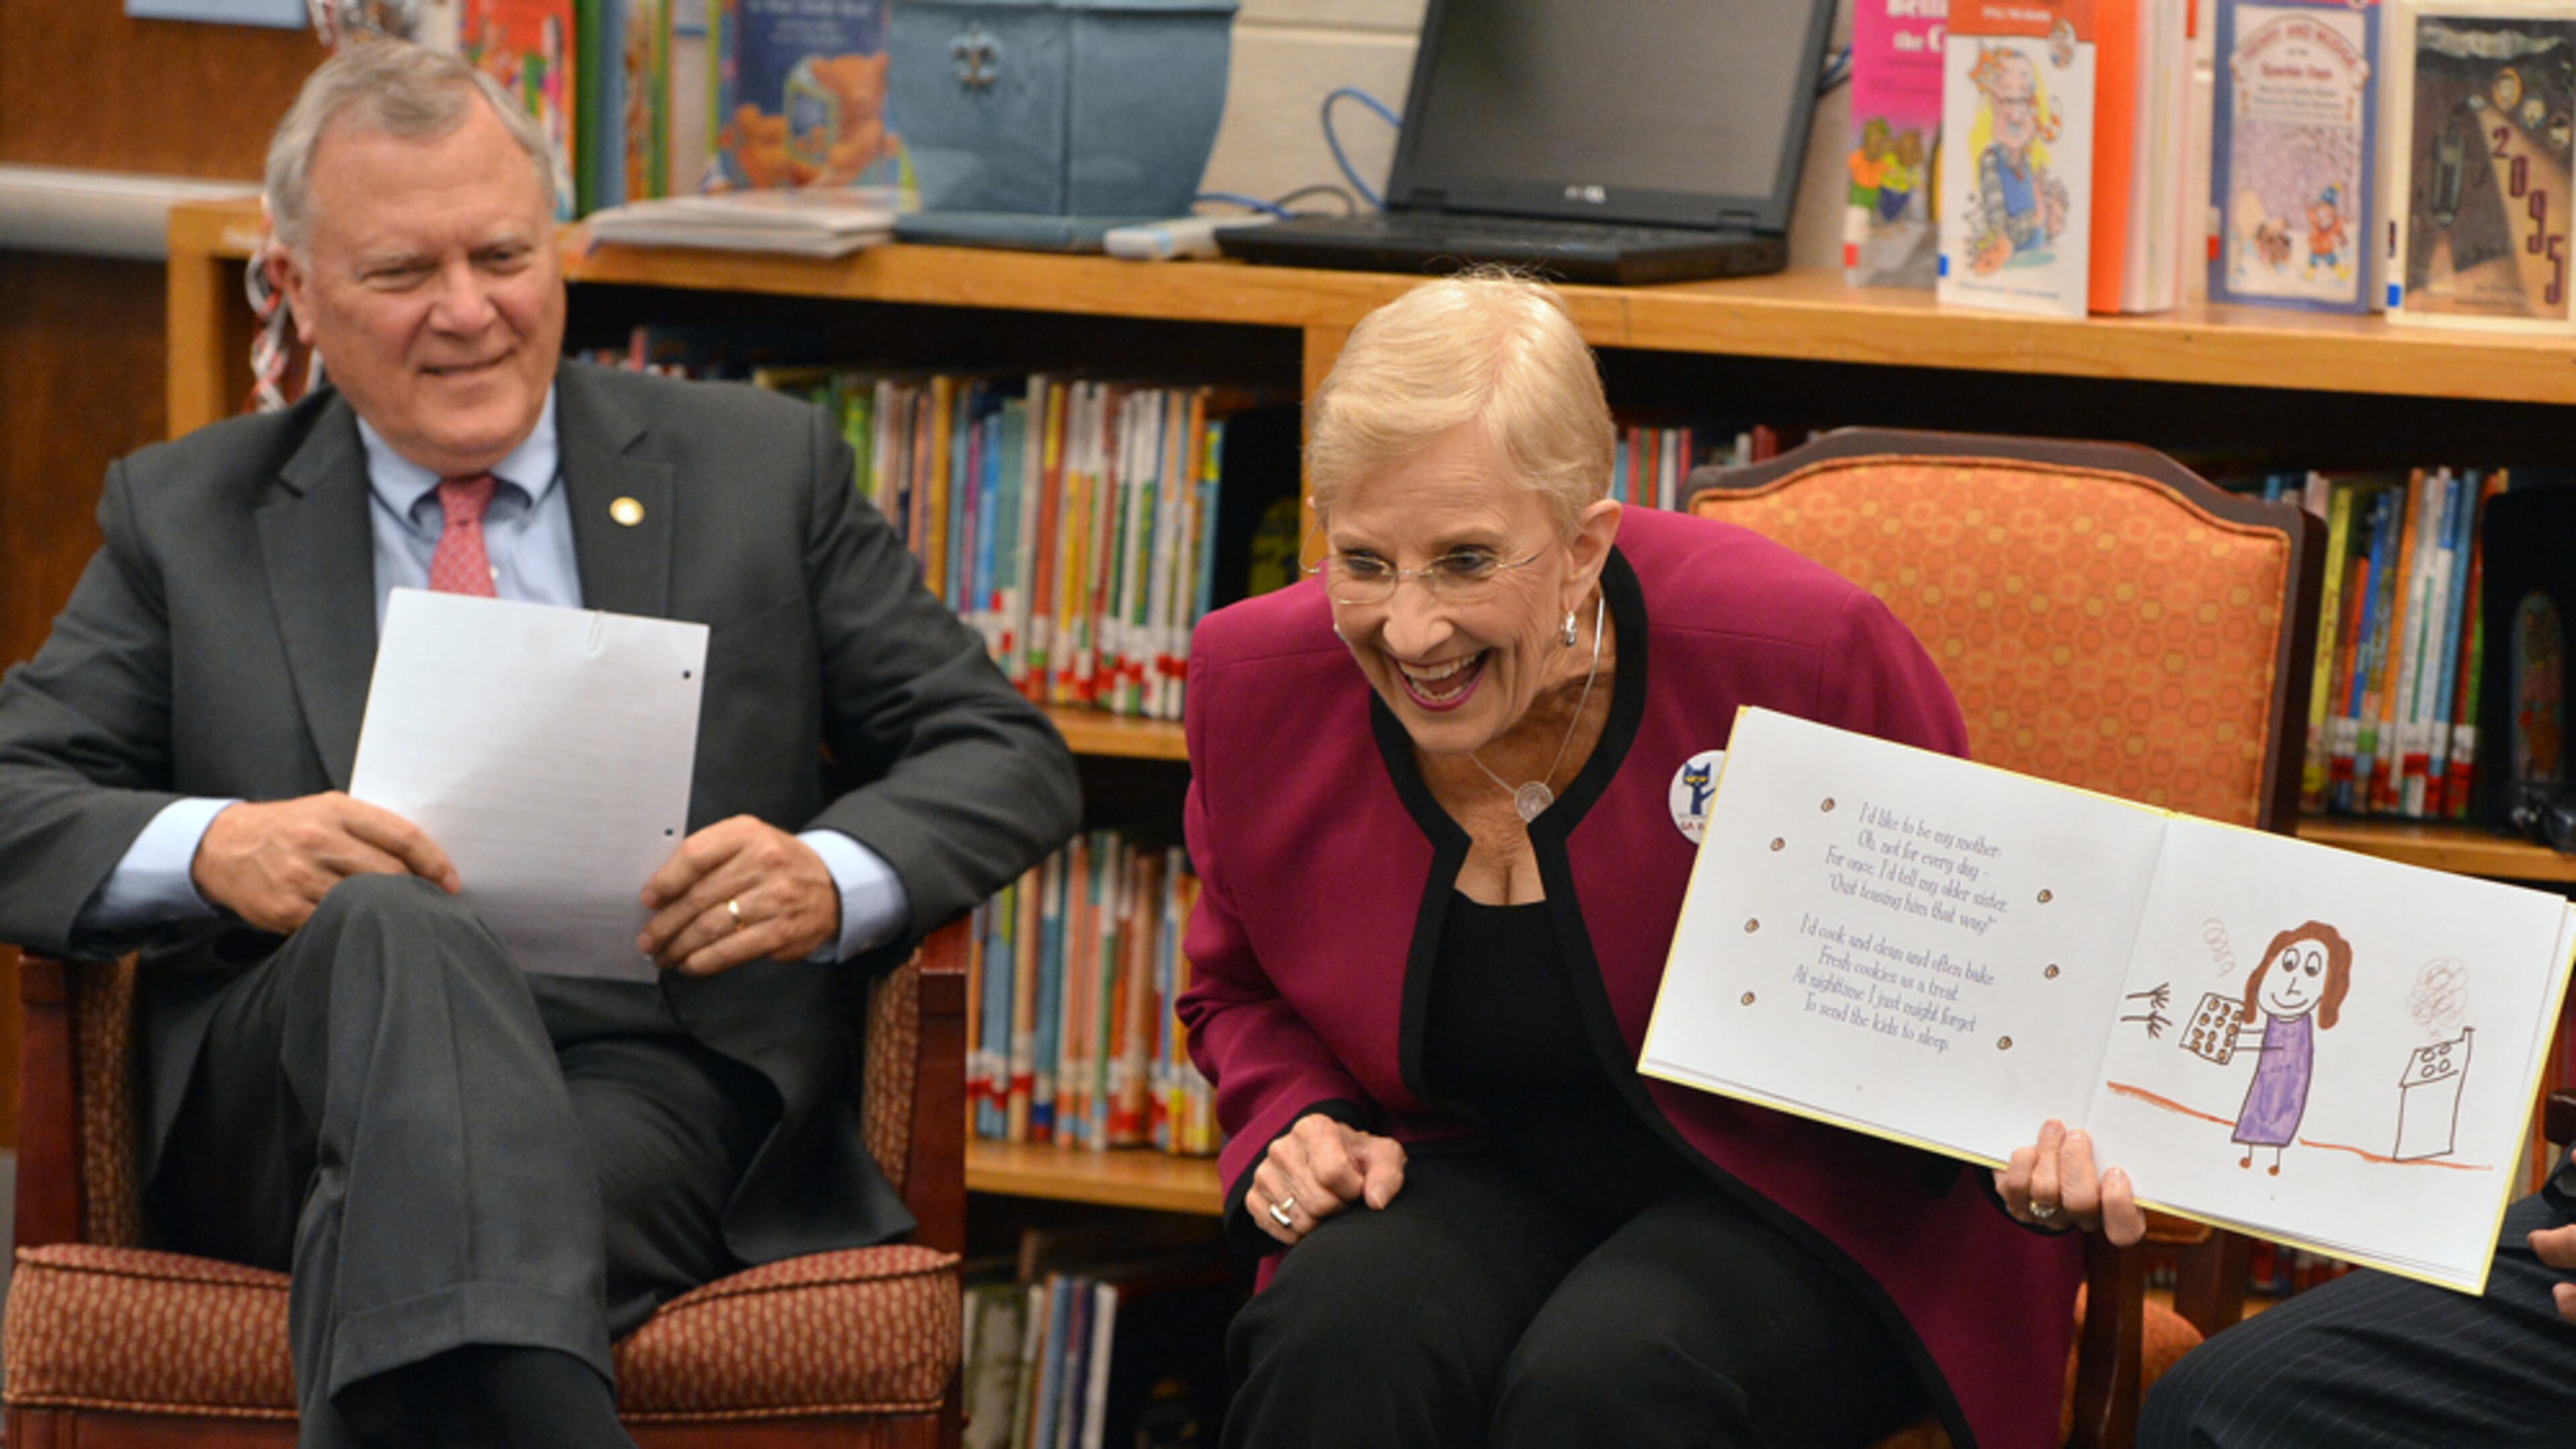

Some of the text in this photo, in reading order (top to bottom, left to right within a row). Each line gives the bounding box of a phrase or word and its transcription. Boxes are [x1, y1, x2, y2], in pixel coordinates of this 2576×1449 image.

[1893, 32, 1925, 52] the
[2493, 127, 2564, 305] 2095
[1902, 815, 1915, 833] to
[1916, 819, 1933, 839] be
[1825, 845, 1845, 867] For
[1940, 879, 1971, 902] older
[1900, 841, 1920, 862] for
[1921, 855, 1955, 875] every
[1818, 944, 1851, 973] Fresh
